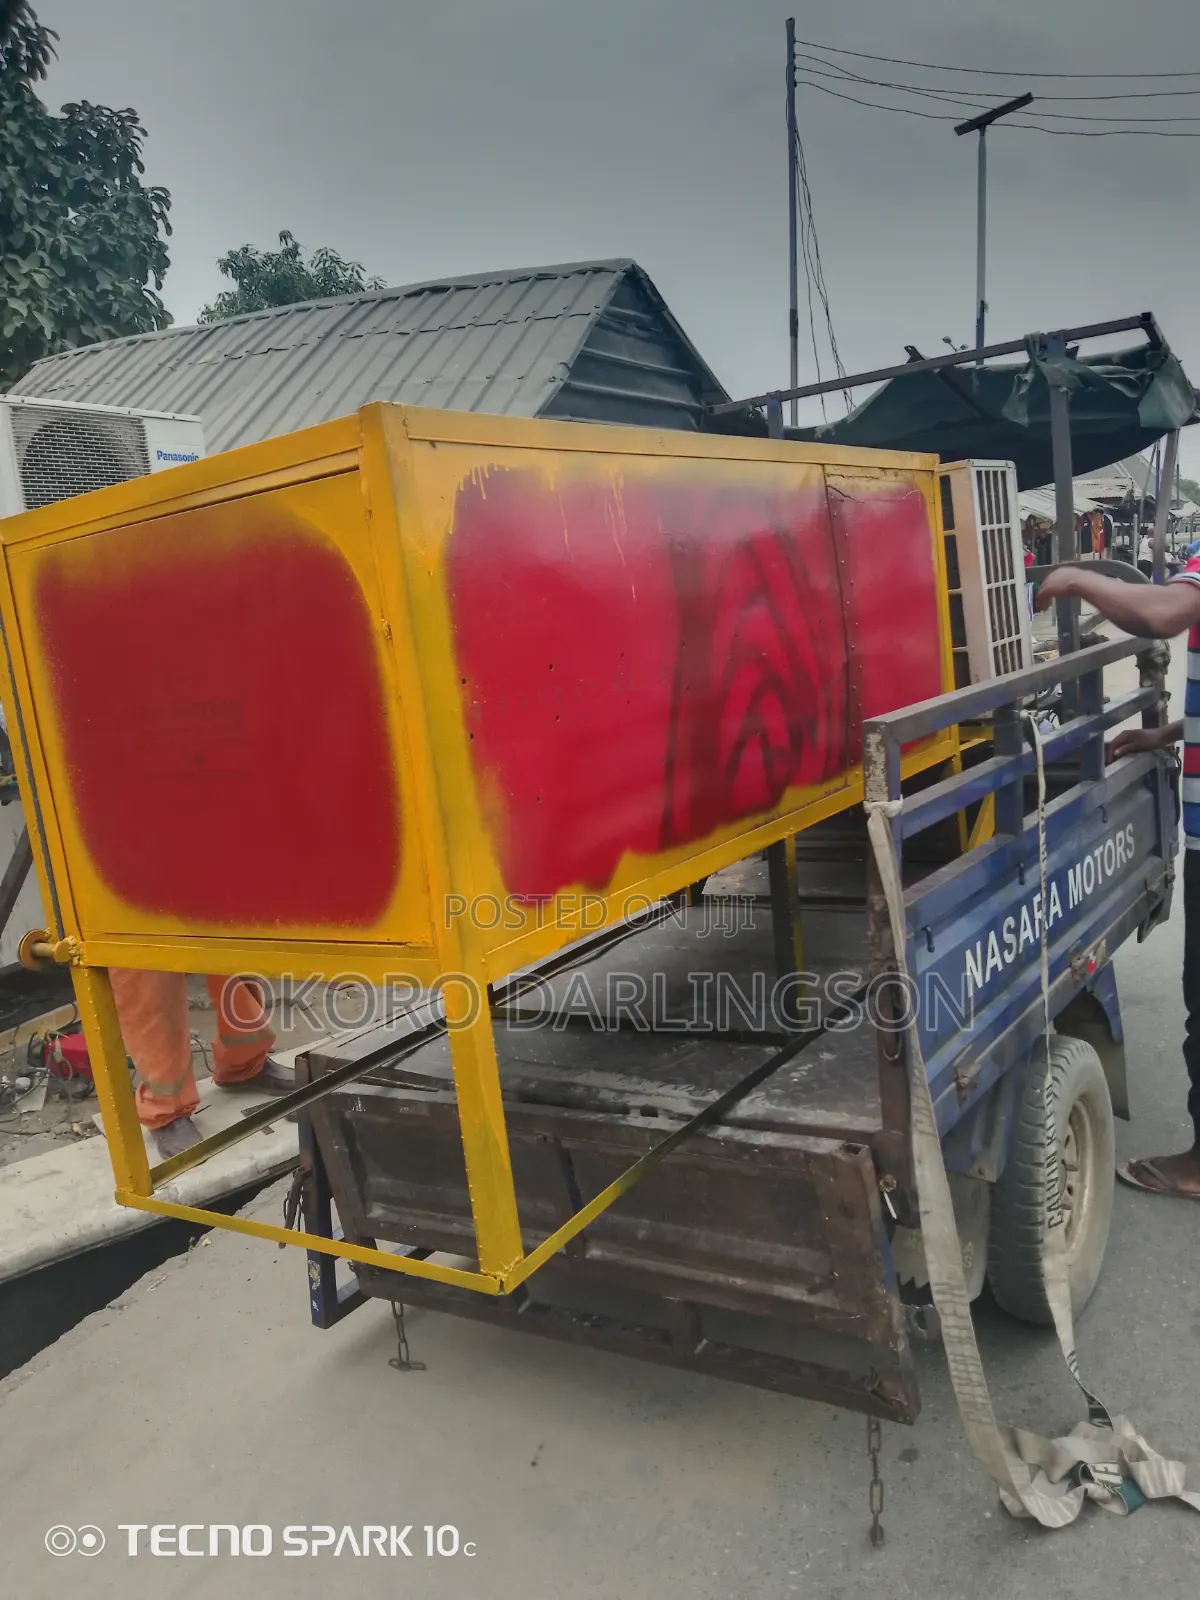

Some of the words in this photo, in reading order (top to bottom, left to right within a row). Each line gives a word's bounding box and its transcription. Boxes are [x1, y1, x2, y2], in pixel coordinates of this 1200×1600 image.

[965, 881, 1063, 997] NASARA
[1067, 823, 1135, 909] MOTORS
[1045, 1150, 1064, 1229] CALVIN
